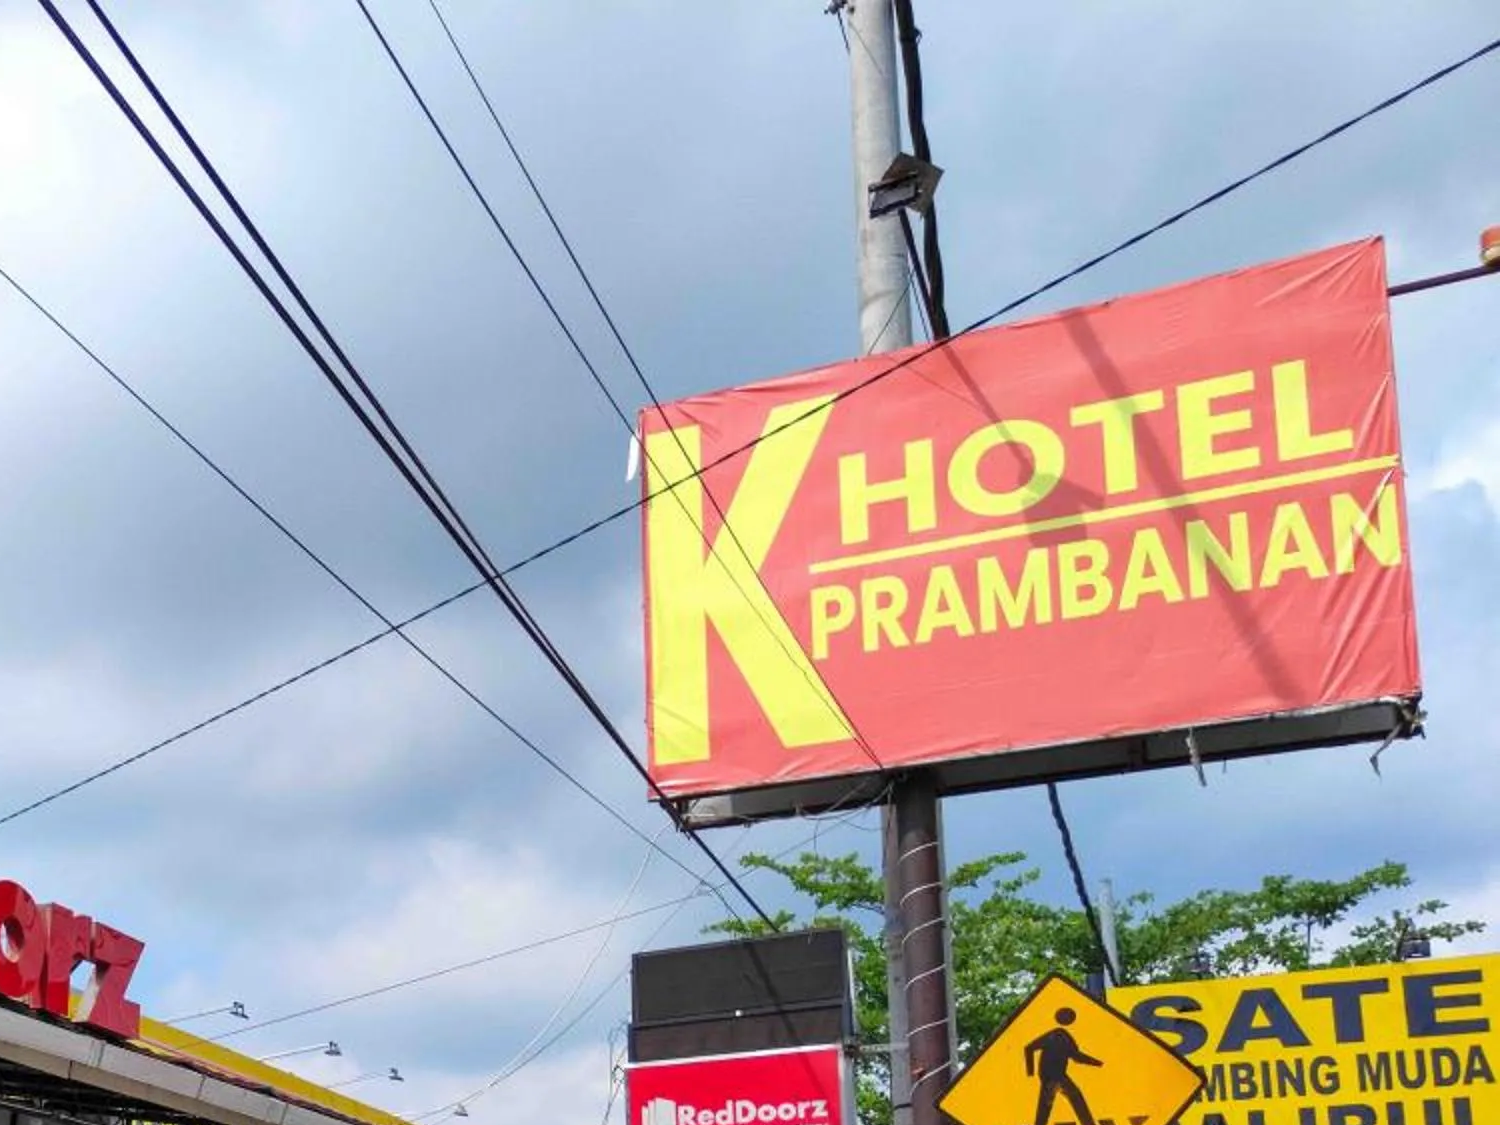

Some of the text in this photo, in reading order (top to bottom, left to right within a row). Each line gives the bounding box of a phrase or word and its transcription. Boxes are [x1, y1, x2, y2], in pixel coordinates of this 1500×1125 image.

[646, 358, 1355, 766] K HOTEL
[809, 483, 1403, 661] PRAMBANAN
[1129, 969, 1491, 1057] SATE
[1197, 1044, 1496, 1103] MBING MUDA
